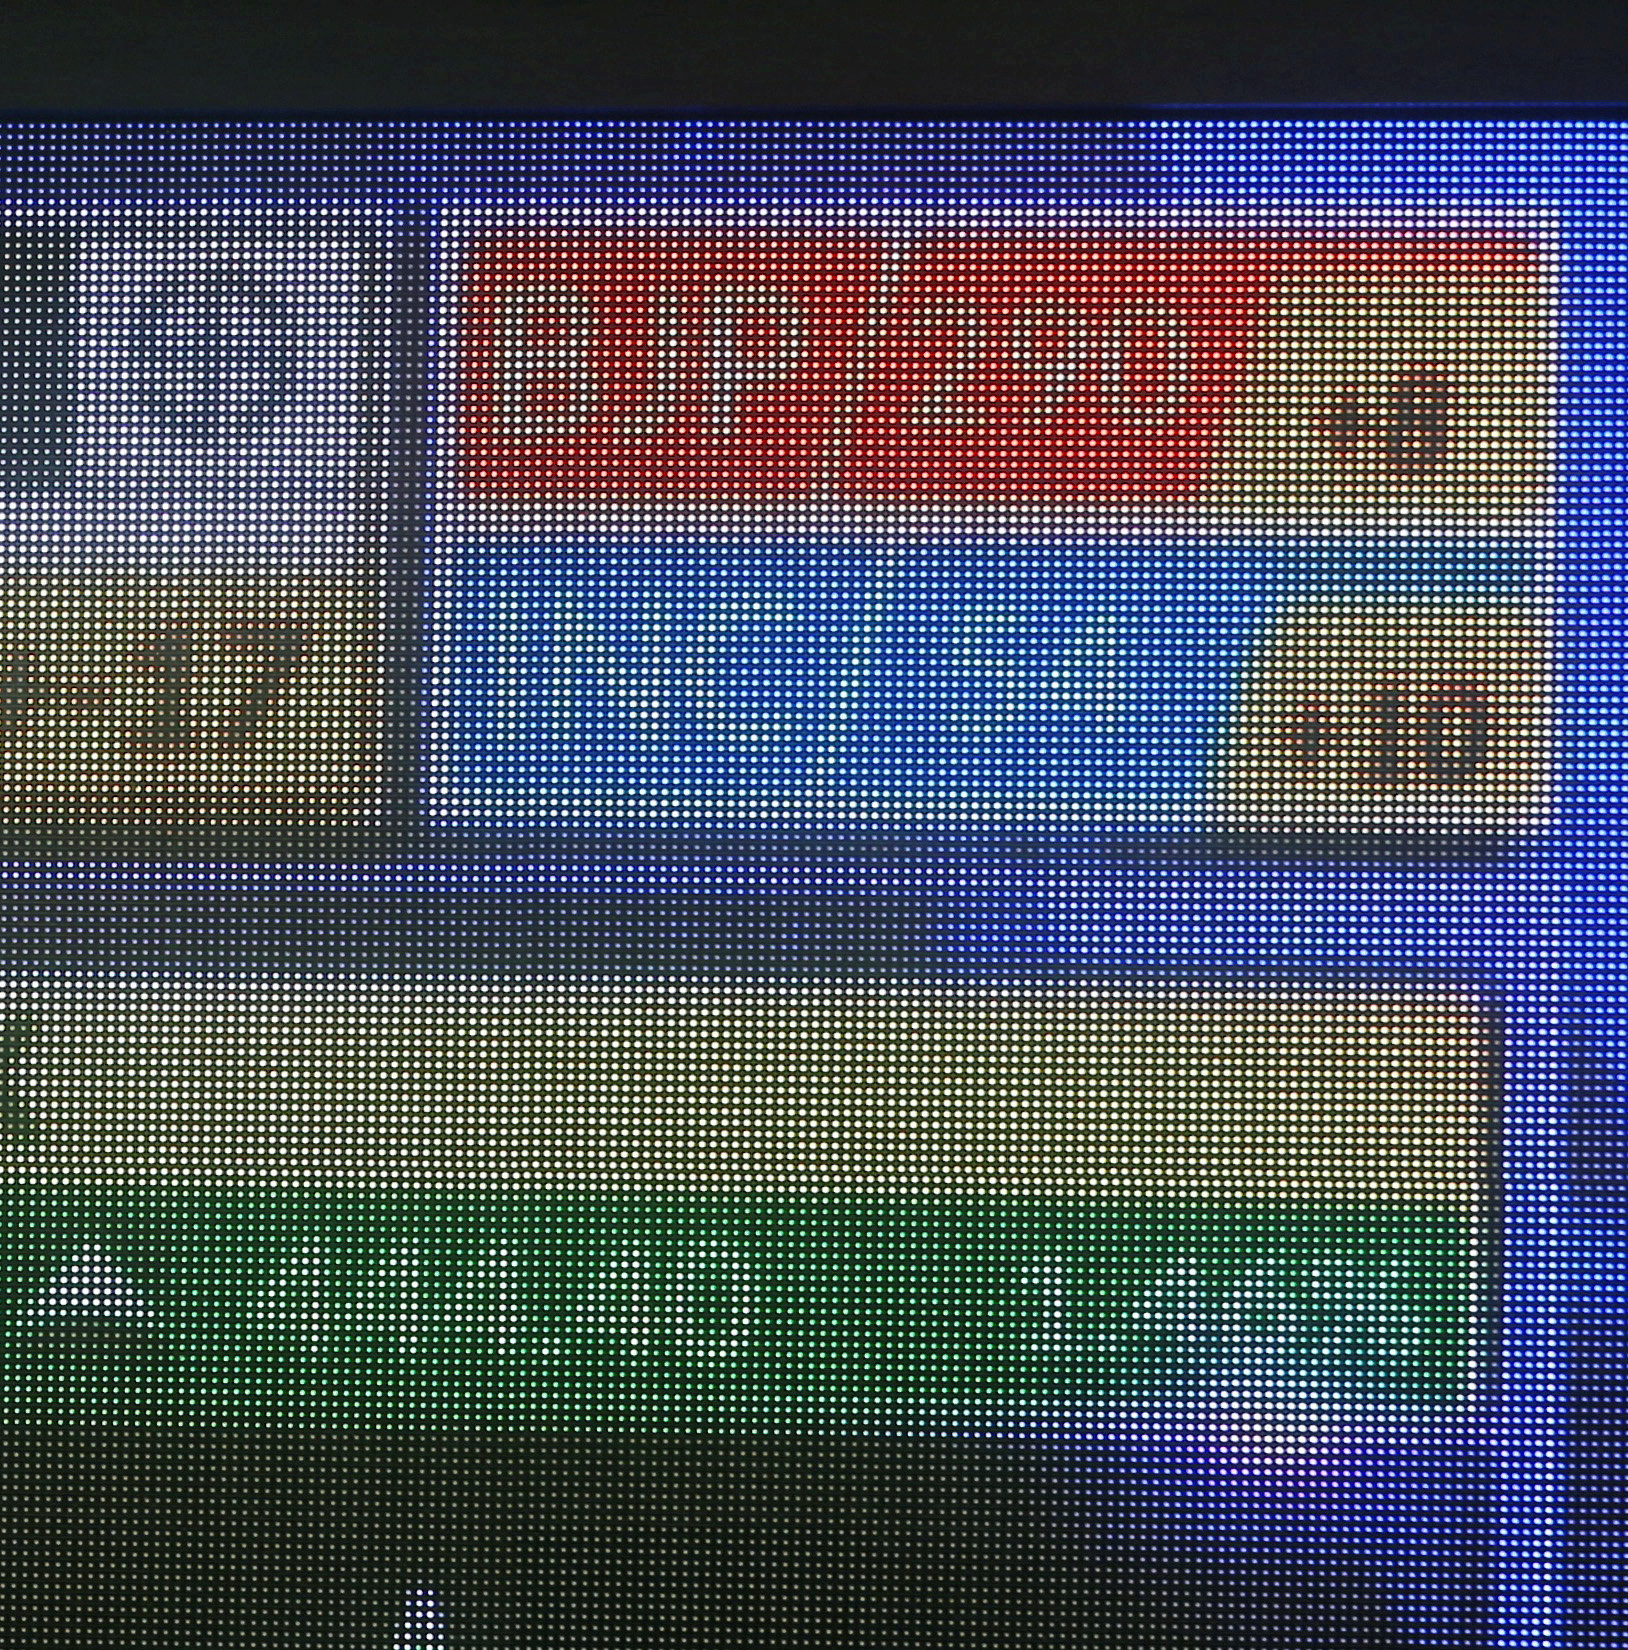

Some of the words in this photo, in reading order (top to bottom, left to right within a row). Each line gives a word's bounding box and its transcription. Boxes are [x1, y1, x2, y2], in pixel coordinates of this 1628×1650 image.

[490, 281, 807, 445] BJP
[905, 298, 1192, 433] 290
[1315, 361, 1452, 479] +8
[490, 587, 799, 752] INC
[947, 607, 1134, 741] 54
[1281, 679, 1493, 789] +10
[246, 1231, 762, 1368] 444.40
[1016, 1245, 1424, 1366] 1.46%
